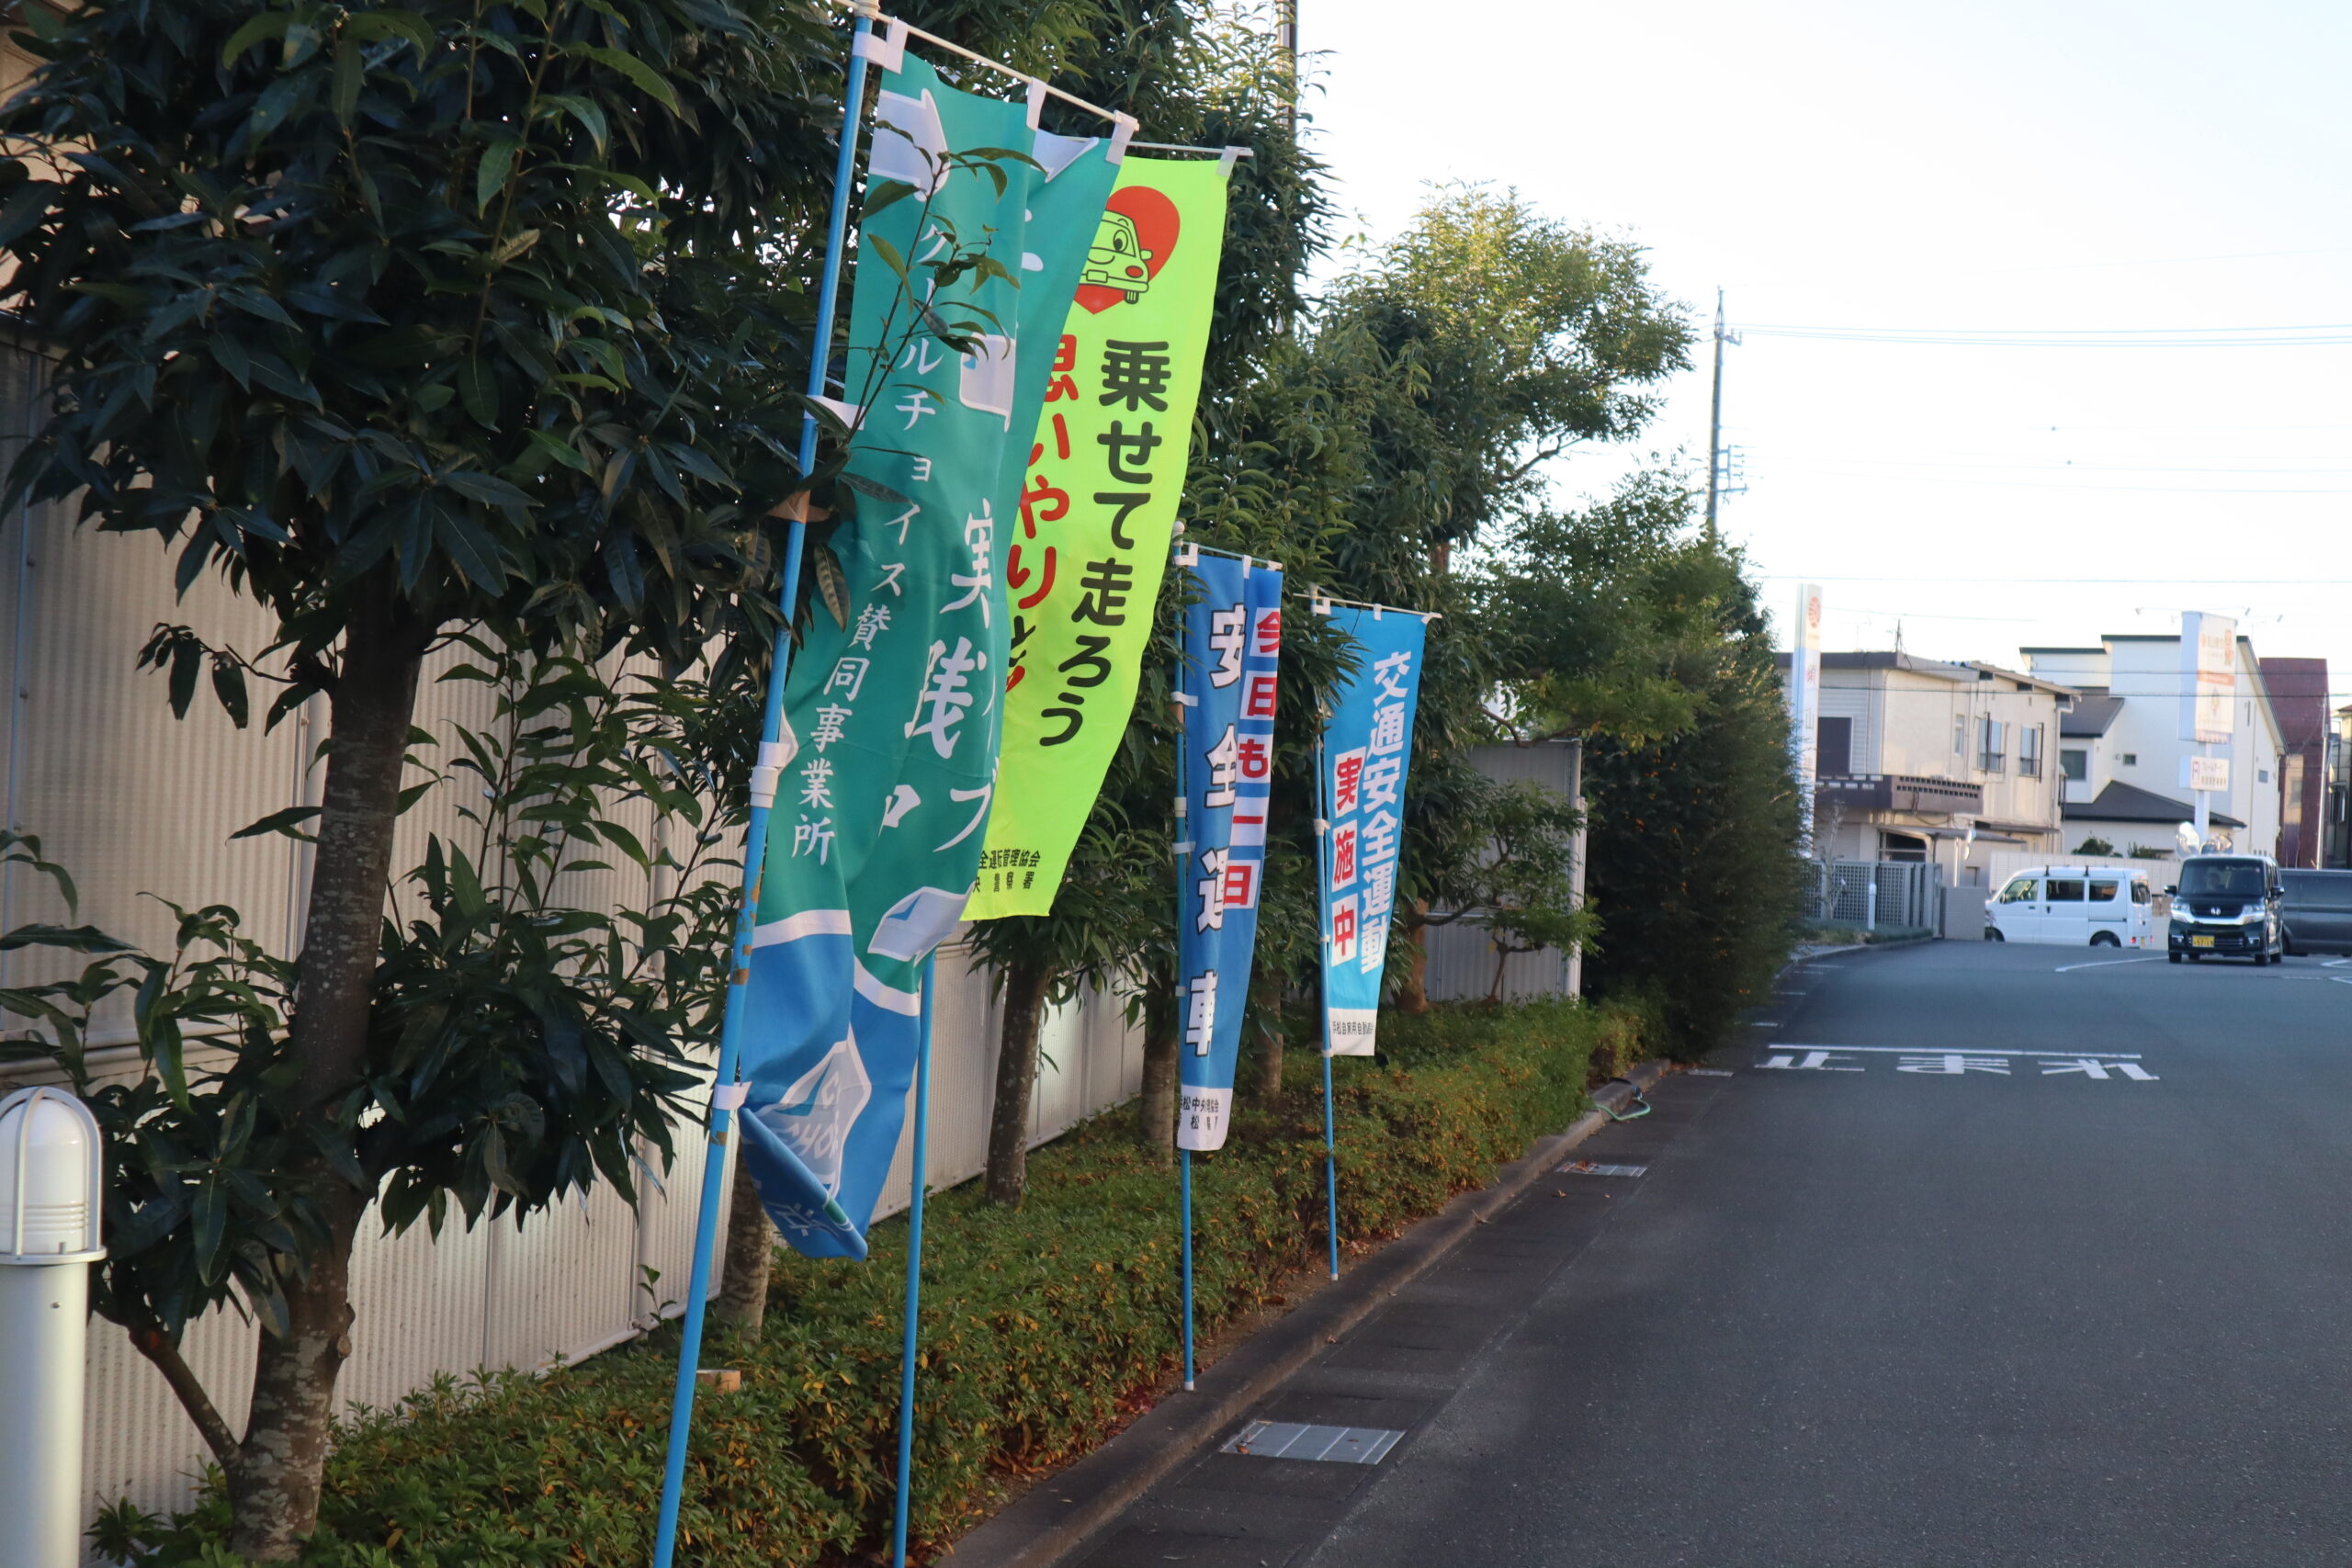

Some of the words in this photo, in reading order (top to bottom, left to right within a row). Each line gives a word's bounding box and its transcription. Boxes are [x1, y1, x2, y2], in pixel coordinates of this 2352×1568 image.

[1040, 339, 1172, 747] 乗せて走ろう
[1224, 611, 1280, 906] 今日も一日
[1333, 756, 1363, 957] 実施中
[1362, 651, 1411, 975] 交通安全運動
[1754, 1051, 2161, 1081] 止まれ
